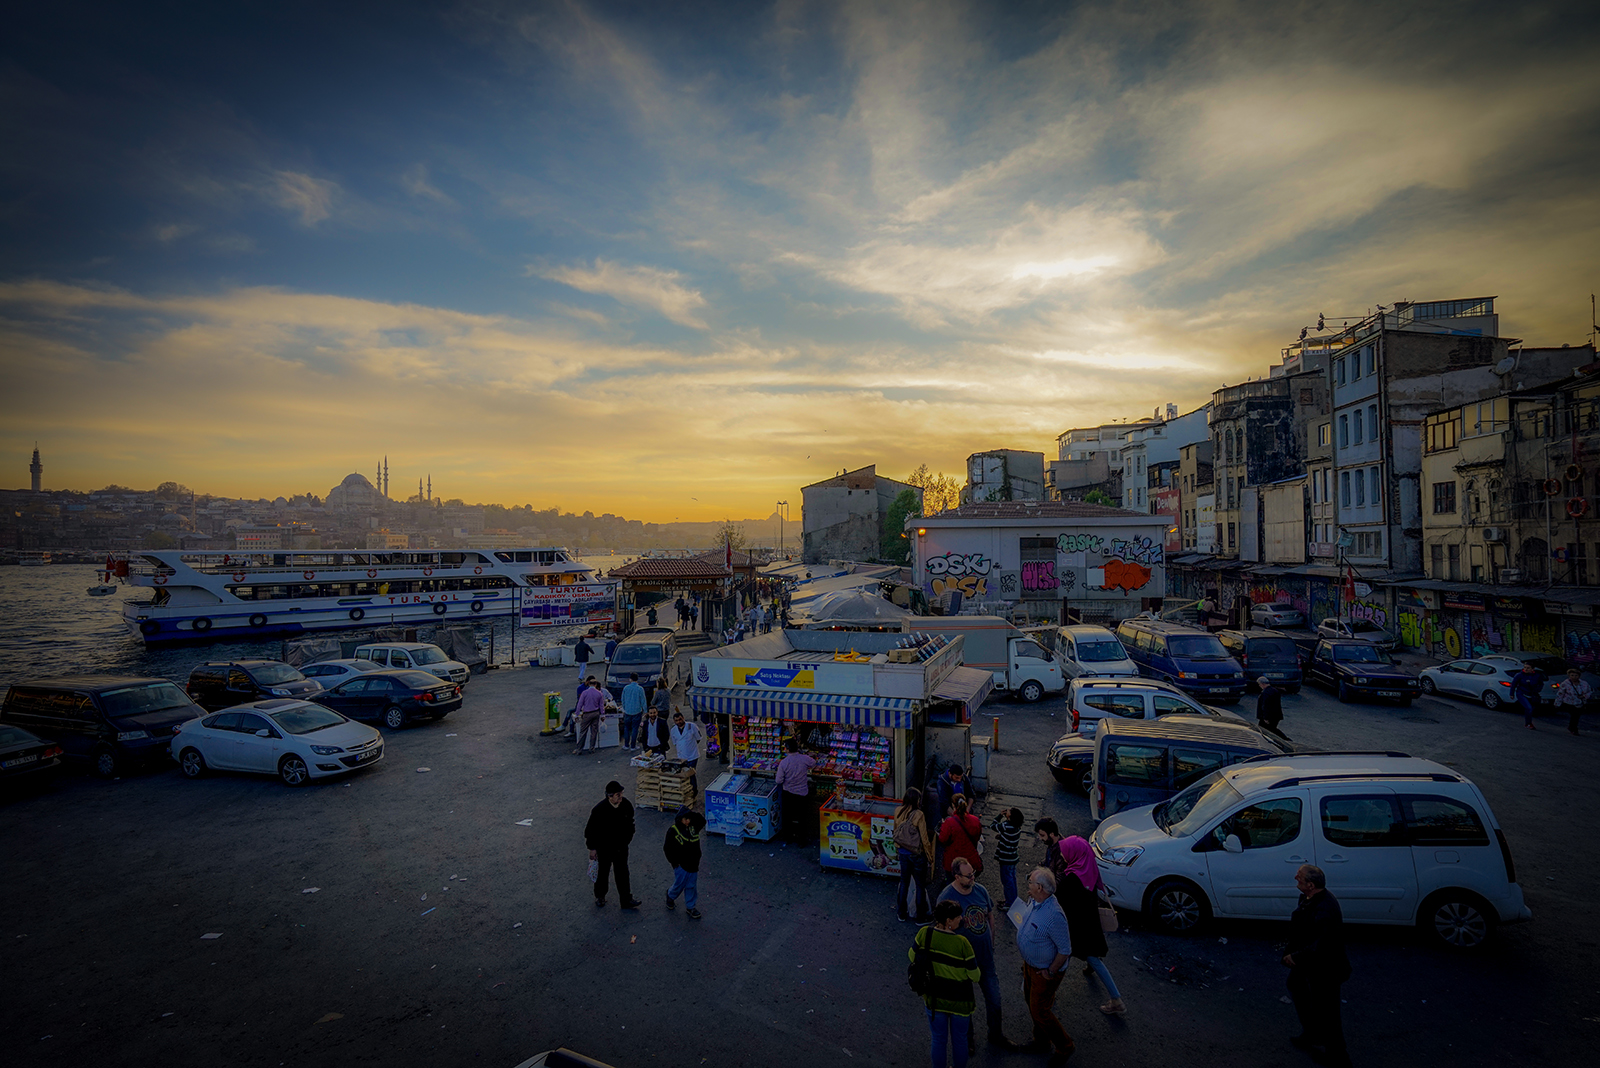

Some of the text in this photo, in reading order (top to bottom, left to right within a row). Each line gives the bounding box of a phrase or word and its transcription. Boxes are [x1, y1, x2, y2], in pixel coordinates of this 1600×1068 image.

[549, 586, 591, 594] TURYOL
[389, 594, 458, 604] TURYOL
[787, 661, 820, 671] İETT
[711, 795, 730, 804] Erikli
[831, 822, 858, 833] Golf
